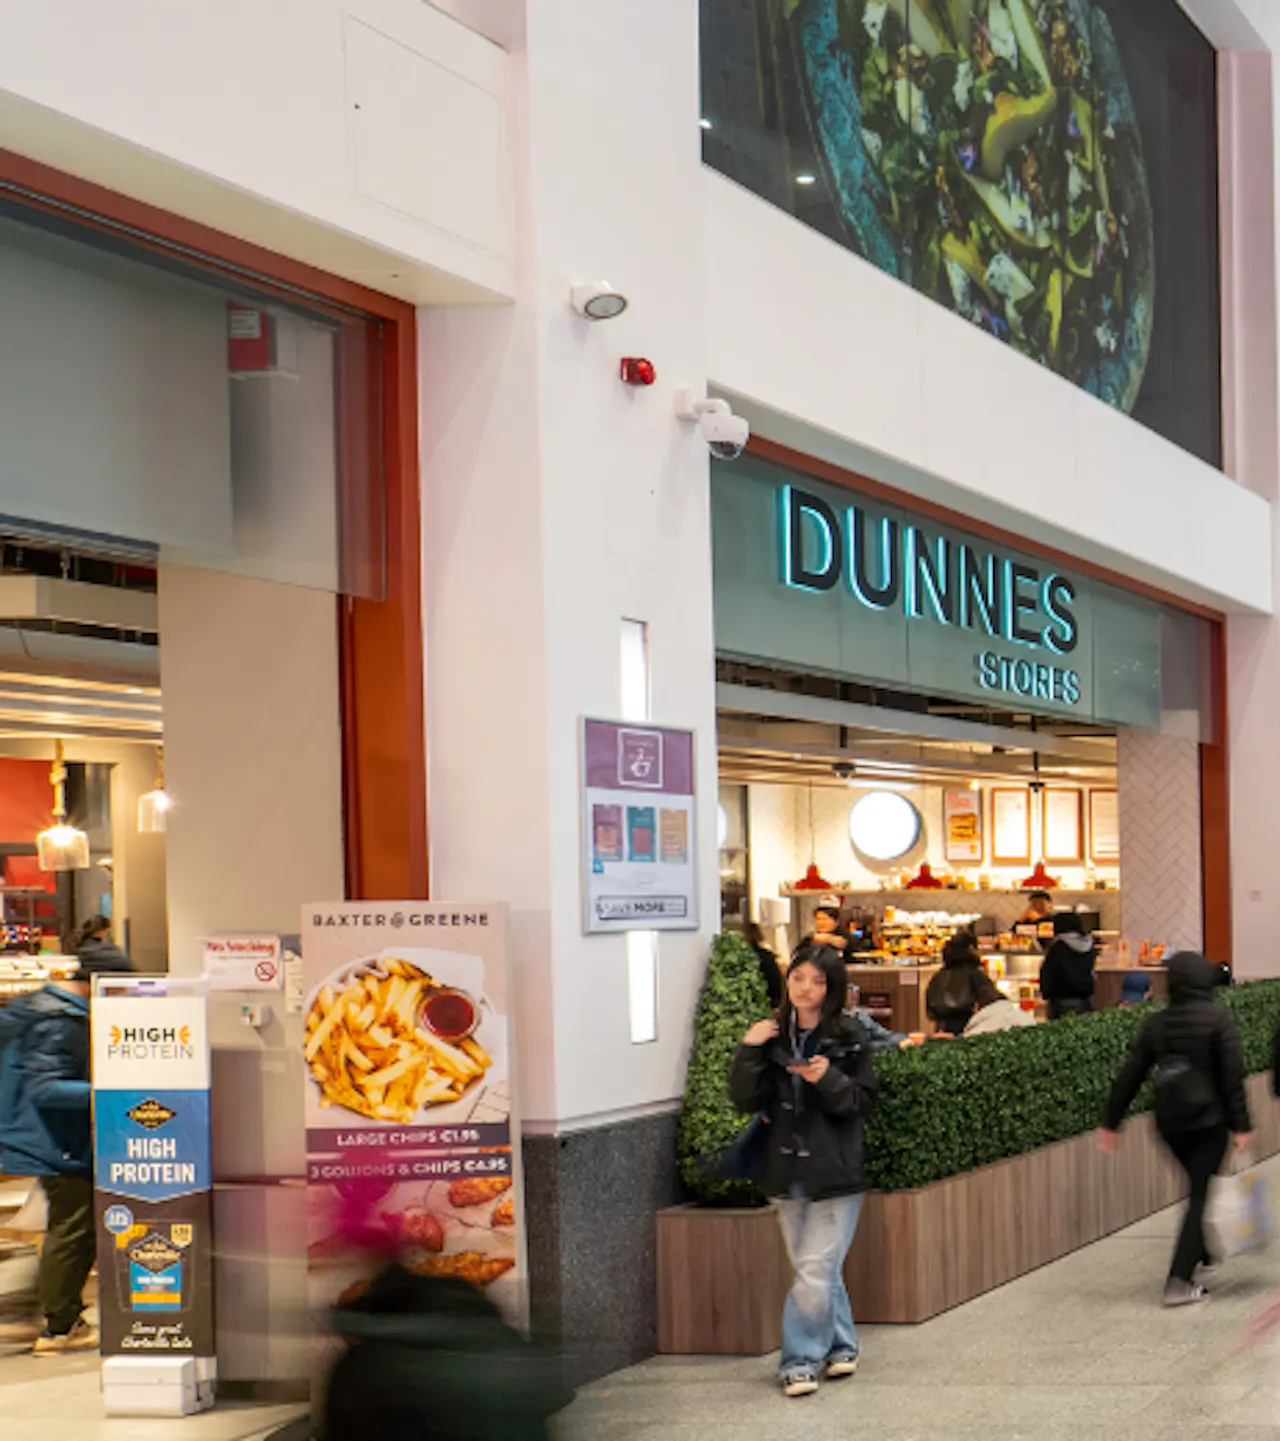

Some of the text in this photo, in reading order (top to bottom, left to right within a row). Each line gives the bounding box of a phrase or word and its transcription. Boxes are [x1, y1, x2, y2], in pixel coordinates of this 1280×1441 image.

[776, 484, 1078, 655] DUNNES
[975, 652, 1080, 704] STORES
[313, 914, 386, 926] BAXTER
[409, 913, 489, 926] GREENE
[124, 1028, 176, 1042] HIGH
[107, 1044, 194, 1059] PROTEIN
[337, 1133, 386, 1146] LARGE
[390, 1131, 437, 1145] CHIPS
[127, 1138, 176, 1158] HIGH
[110, 1163, 195, 1184] PROTEIN
[412, 1161, 461, 1174] CHIPS
